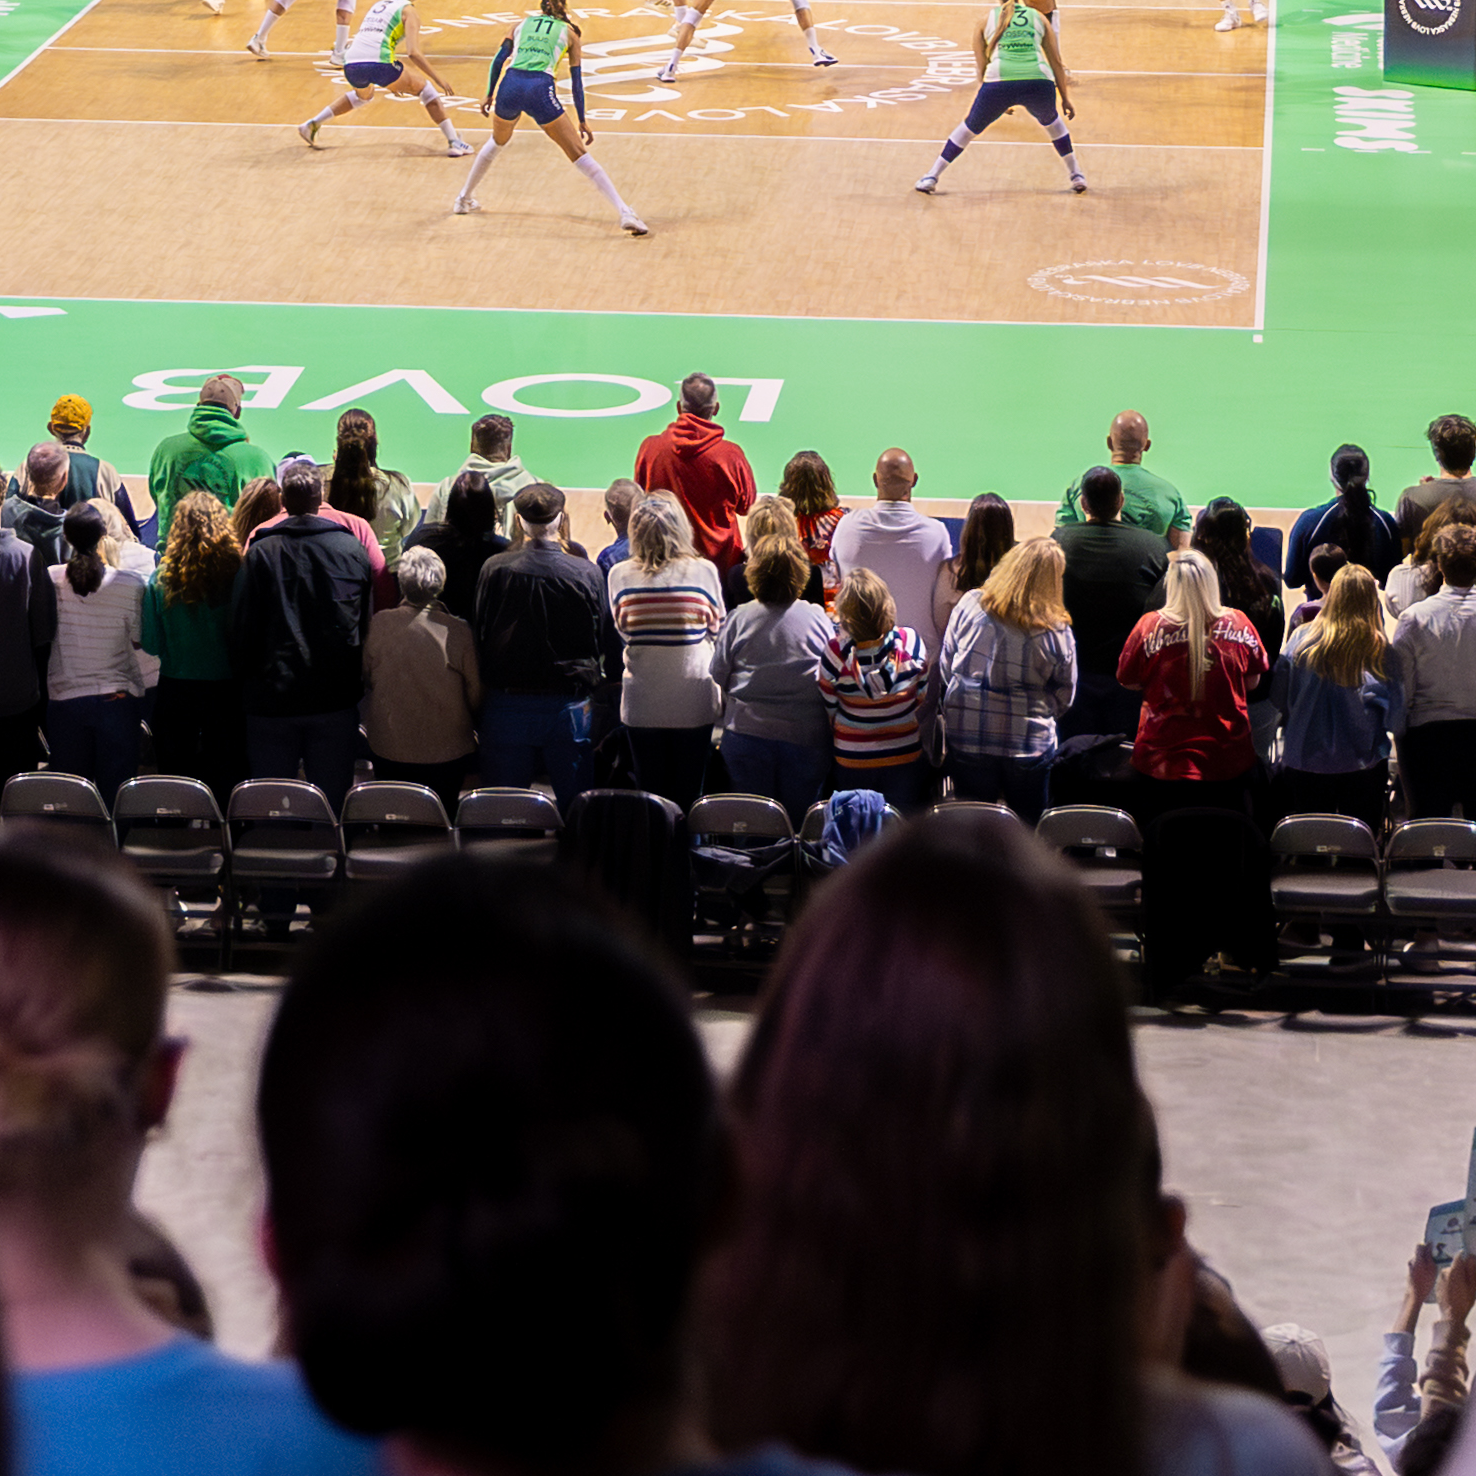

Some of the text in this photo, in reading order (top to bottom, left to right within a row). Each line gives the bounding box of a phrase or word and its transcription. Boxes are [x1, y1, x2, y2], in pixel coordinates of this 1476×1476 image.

[533, 18, 554, 35] 11
[1332, 86, 1419, 152] SKIMS
[122, 365, 784, 422] LOVB
